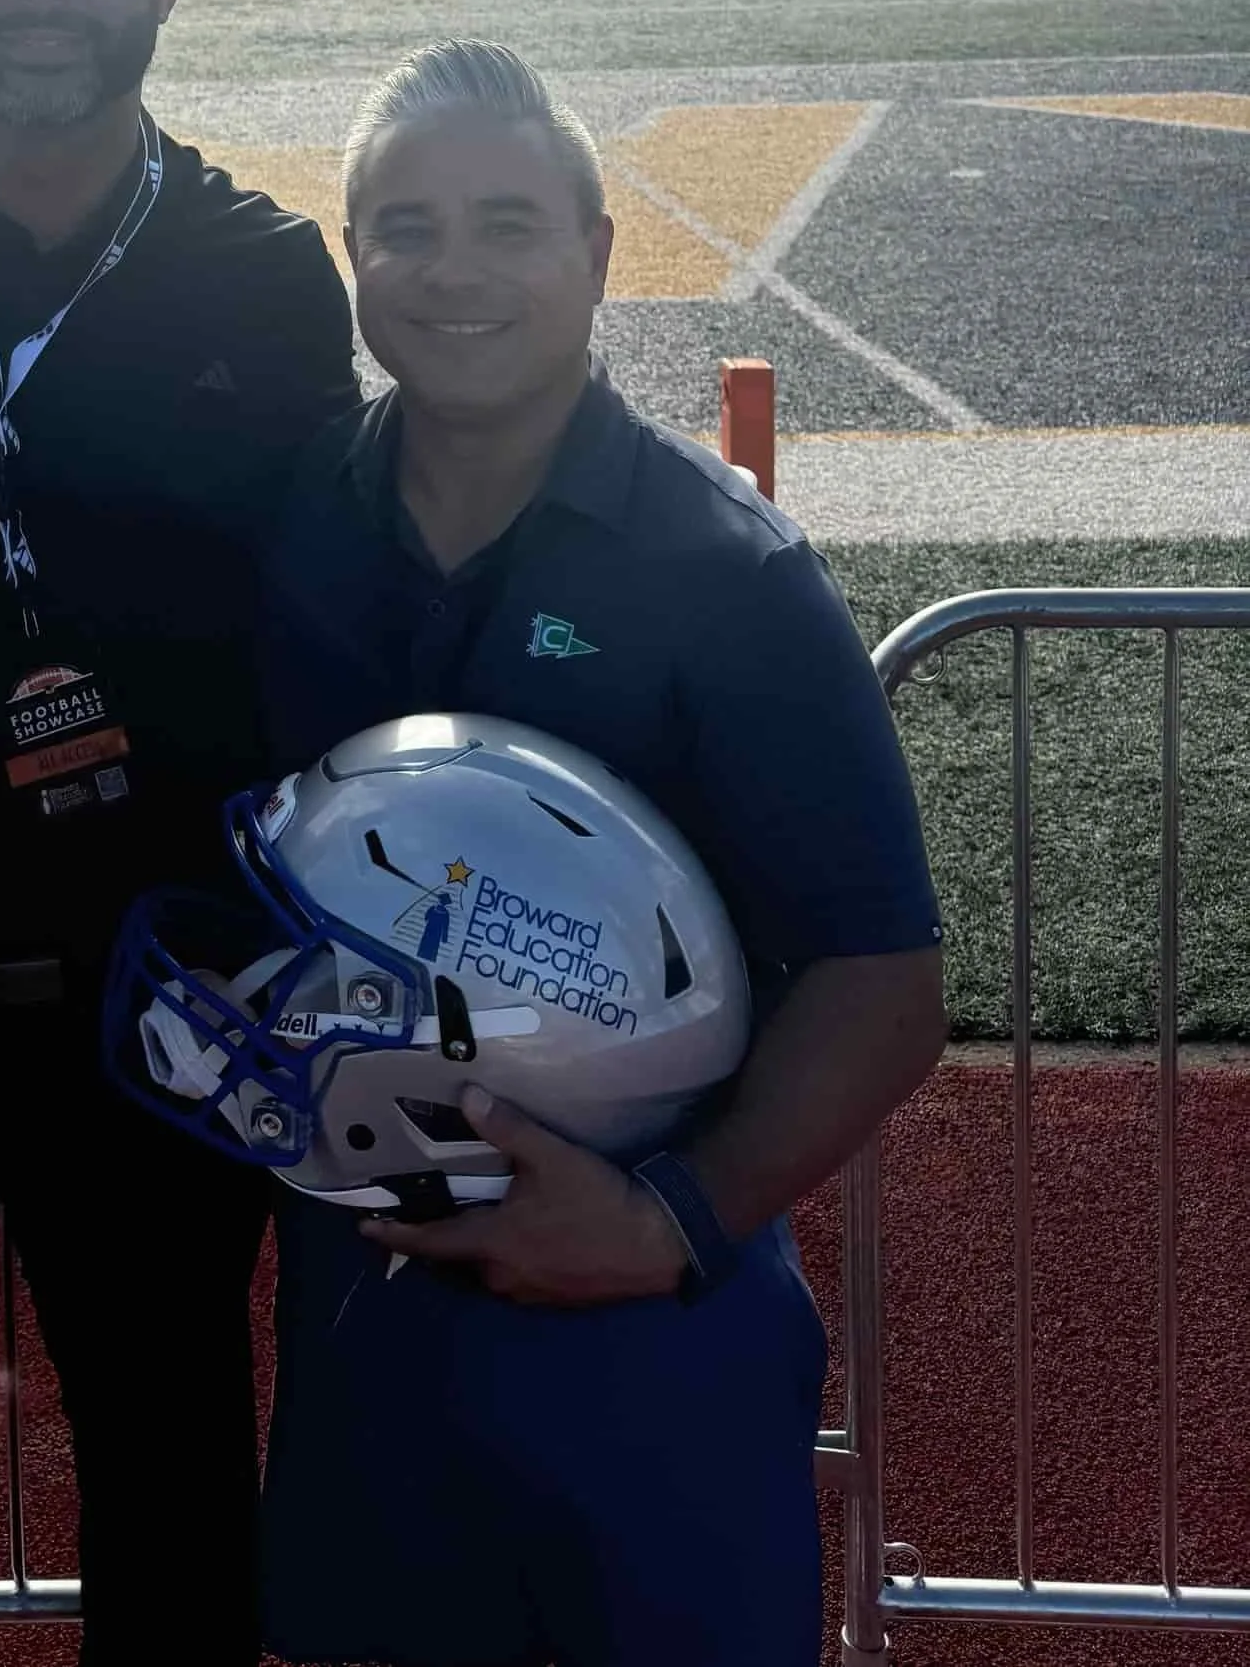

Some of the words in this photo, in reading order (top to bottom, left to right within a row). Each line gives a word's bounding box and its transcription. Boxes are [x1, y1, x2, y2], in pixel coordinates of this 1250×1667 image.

[542, 625, 567, 649] C
[9, 687, 102, 727] FOOTBALL
[14, 701, 106, 741] SHOWCASE
[475, 875, 603, 951] Broward
[466, 906, 629, 998] Education
[456, 939, 639, 1037] Foundation
[275, 1013, 318, 1036] dell
